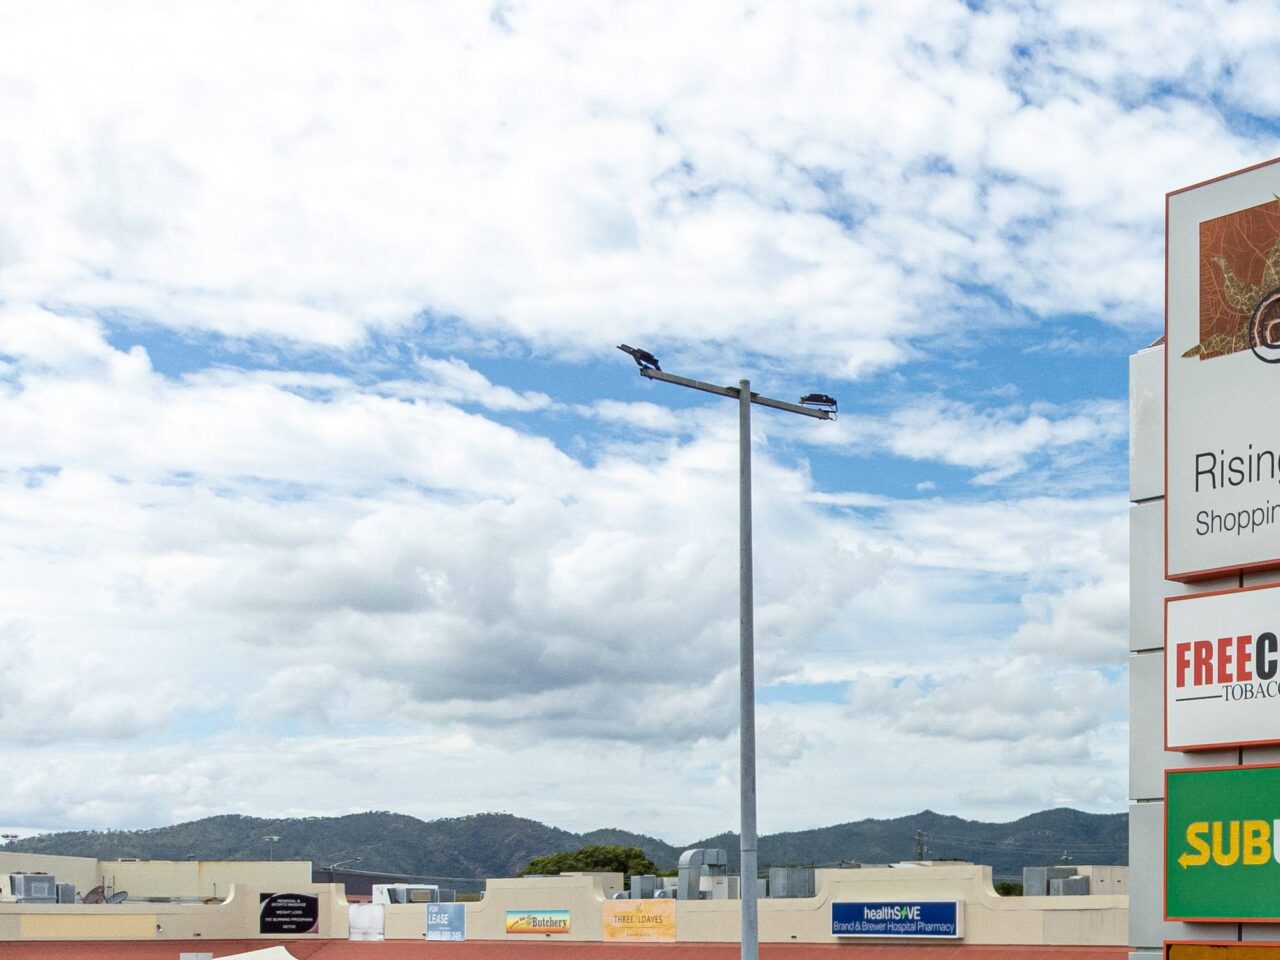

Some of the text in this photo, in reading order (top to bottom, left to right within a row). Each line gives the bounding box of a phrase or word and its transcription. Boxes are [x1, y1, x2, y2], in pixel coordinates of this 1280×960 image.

[428, 905, 439, 913] FOR
[428, 913, 449, 925] LEASE
[532, 916, 568, 929] Butchery
[614, 915, 663, 924] THREE LOAVES
[833, 921, 955, 935] Brand & Brewer Hospital Pharmacy
